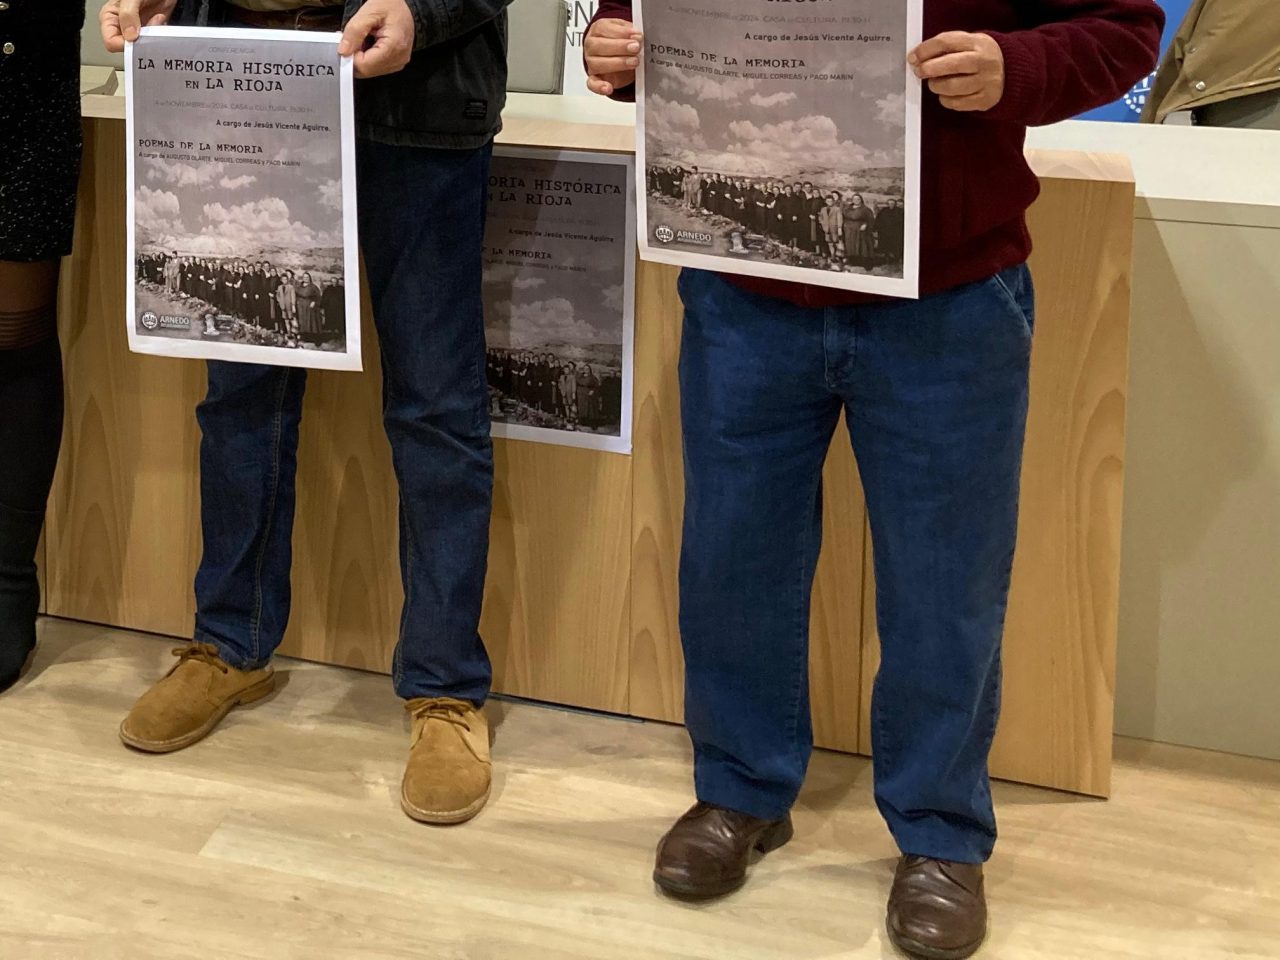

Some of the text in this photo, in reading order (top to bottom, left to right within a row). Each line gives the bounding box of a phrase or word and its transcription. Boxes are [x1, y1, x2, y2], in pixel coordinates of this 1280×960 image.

[745, 32, 750, 40] A
[753, 34, 777, 42] cargo
[650, 44, 805, 68] POEMAS DE LA MEMORIA
[138, 59, 334, 77] LA MEMORIA HISTÓRICA
[185, 78, 283, 92] EN LA RIOJA
[139, 139, 174, 148] POEMAS
[181, 142, 193, 150] DE
[217, 144, 263, 153] MEMORIA
[535, 178, 621, 194] HISTÓRICA
[500, 191, 572, 206] LA RIOJA
[677, 230, 712, 242] ARNEDO
[160, 315, 190, 325] ARNEDO
